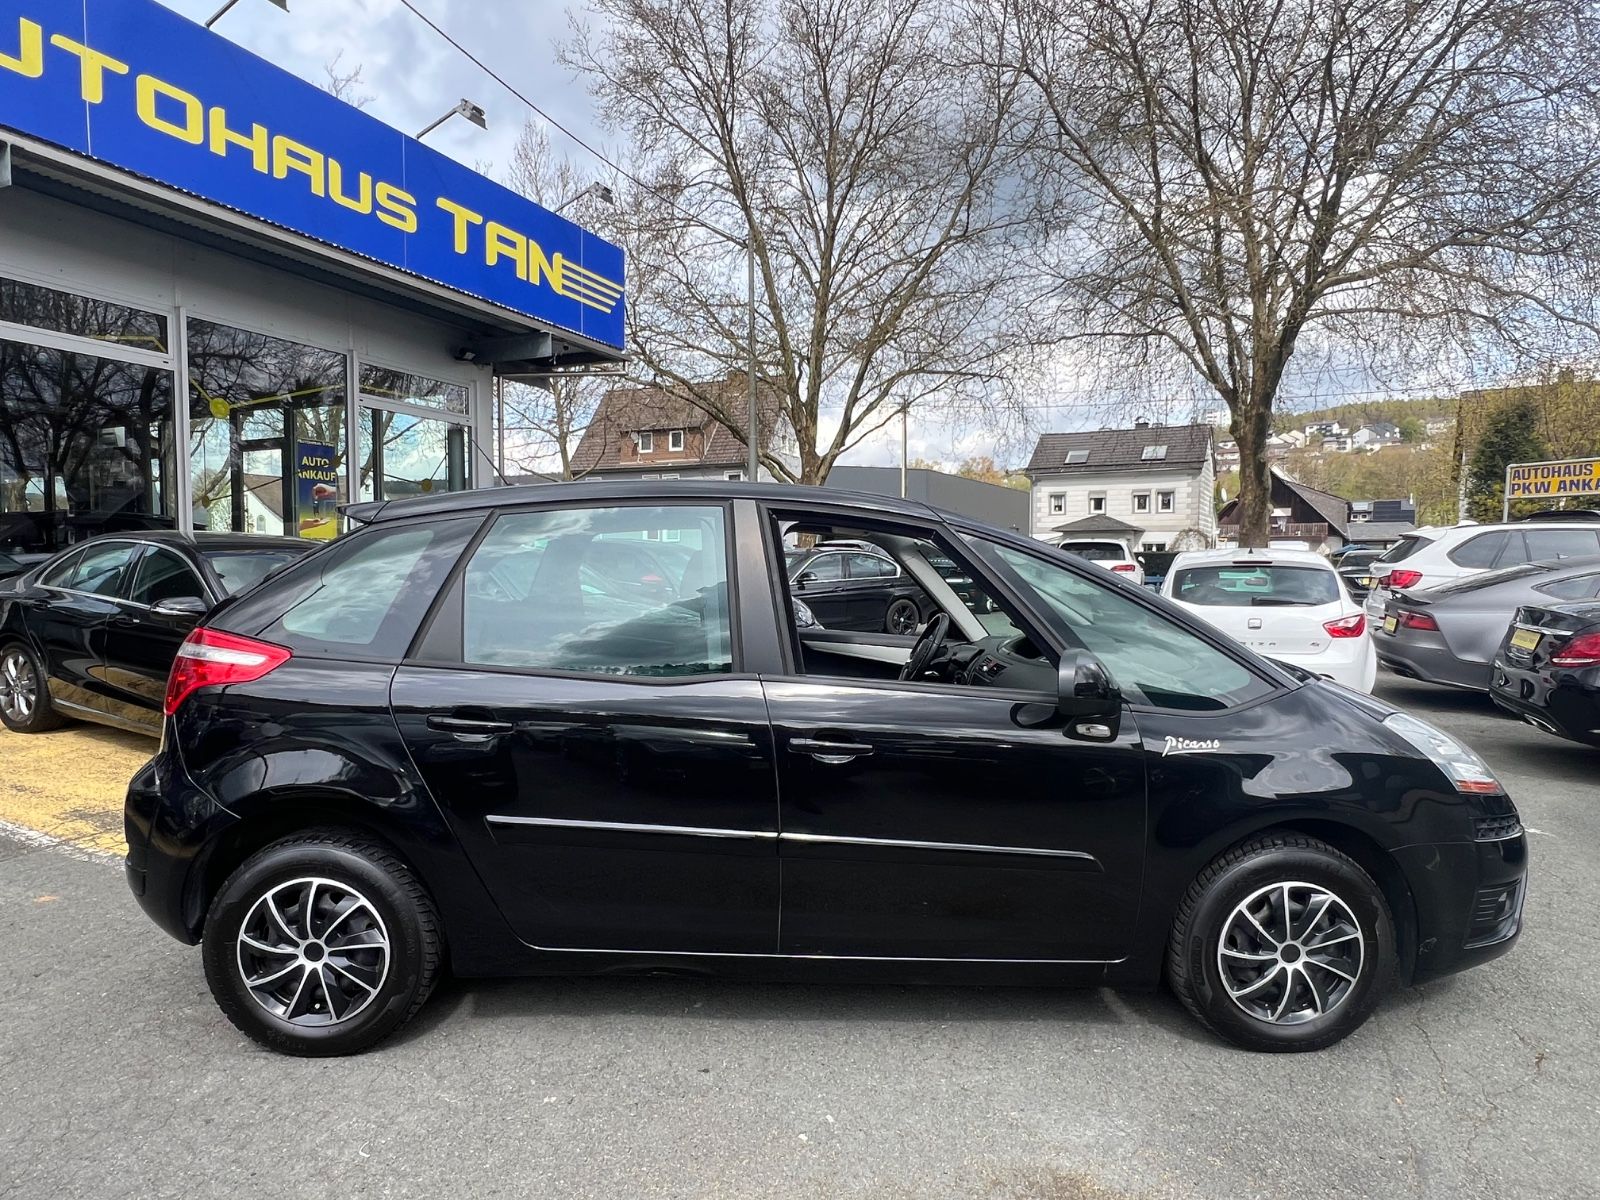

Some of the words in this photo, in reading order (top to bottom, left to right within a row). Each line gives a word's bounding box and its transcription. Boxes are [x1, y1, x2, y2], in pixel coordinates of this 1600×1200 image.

[436, 197, 564, 295] TAN
[301, 456, 329, 467] AUTO
[1512, 464, 1593, 480] AUTOHAUS
[1511, 480, 1551, 495] PKW
[1162, 735, 1220, 757] Picasso
